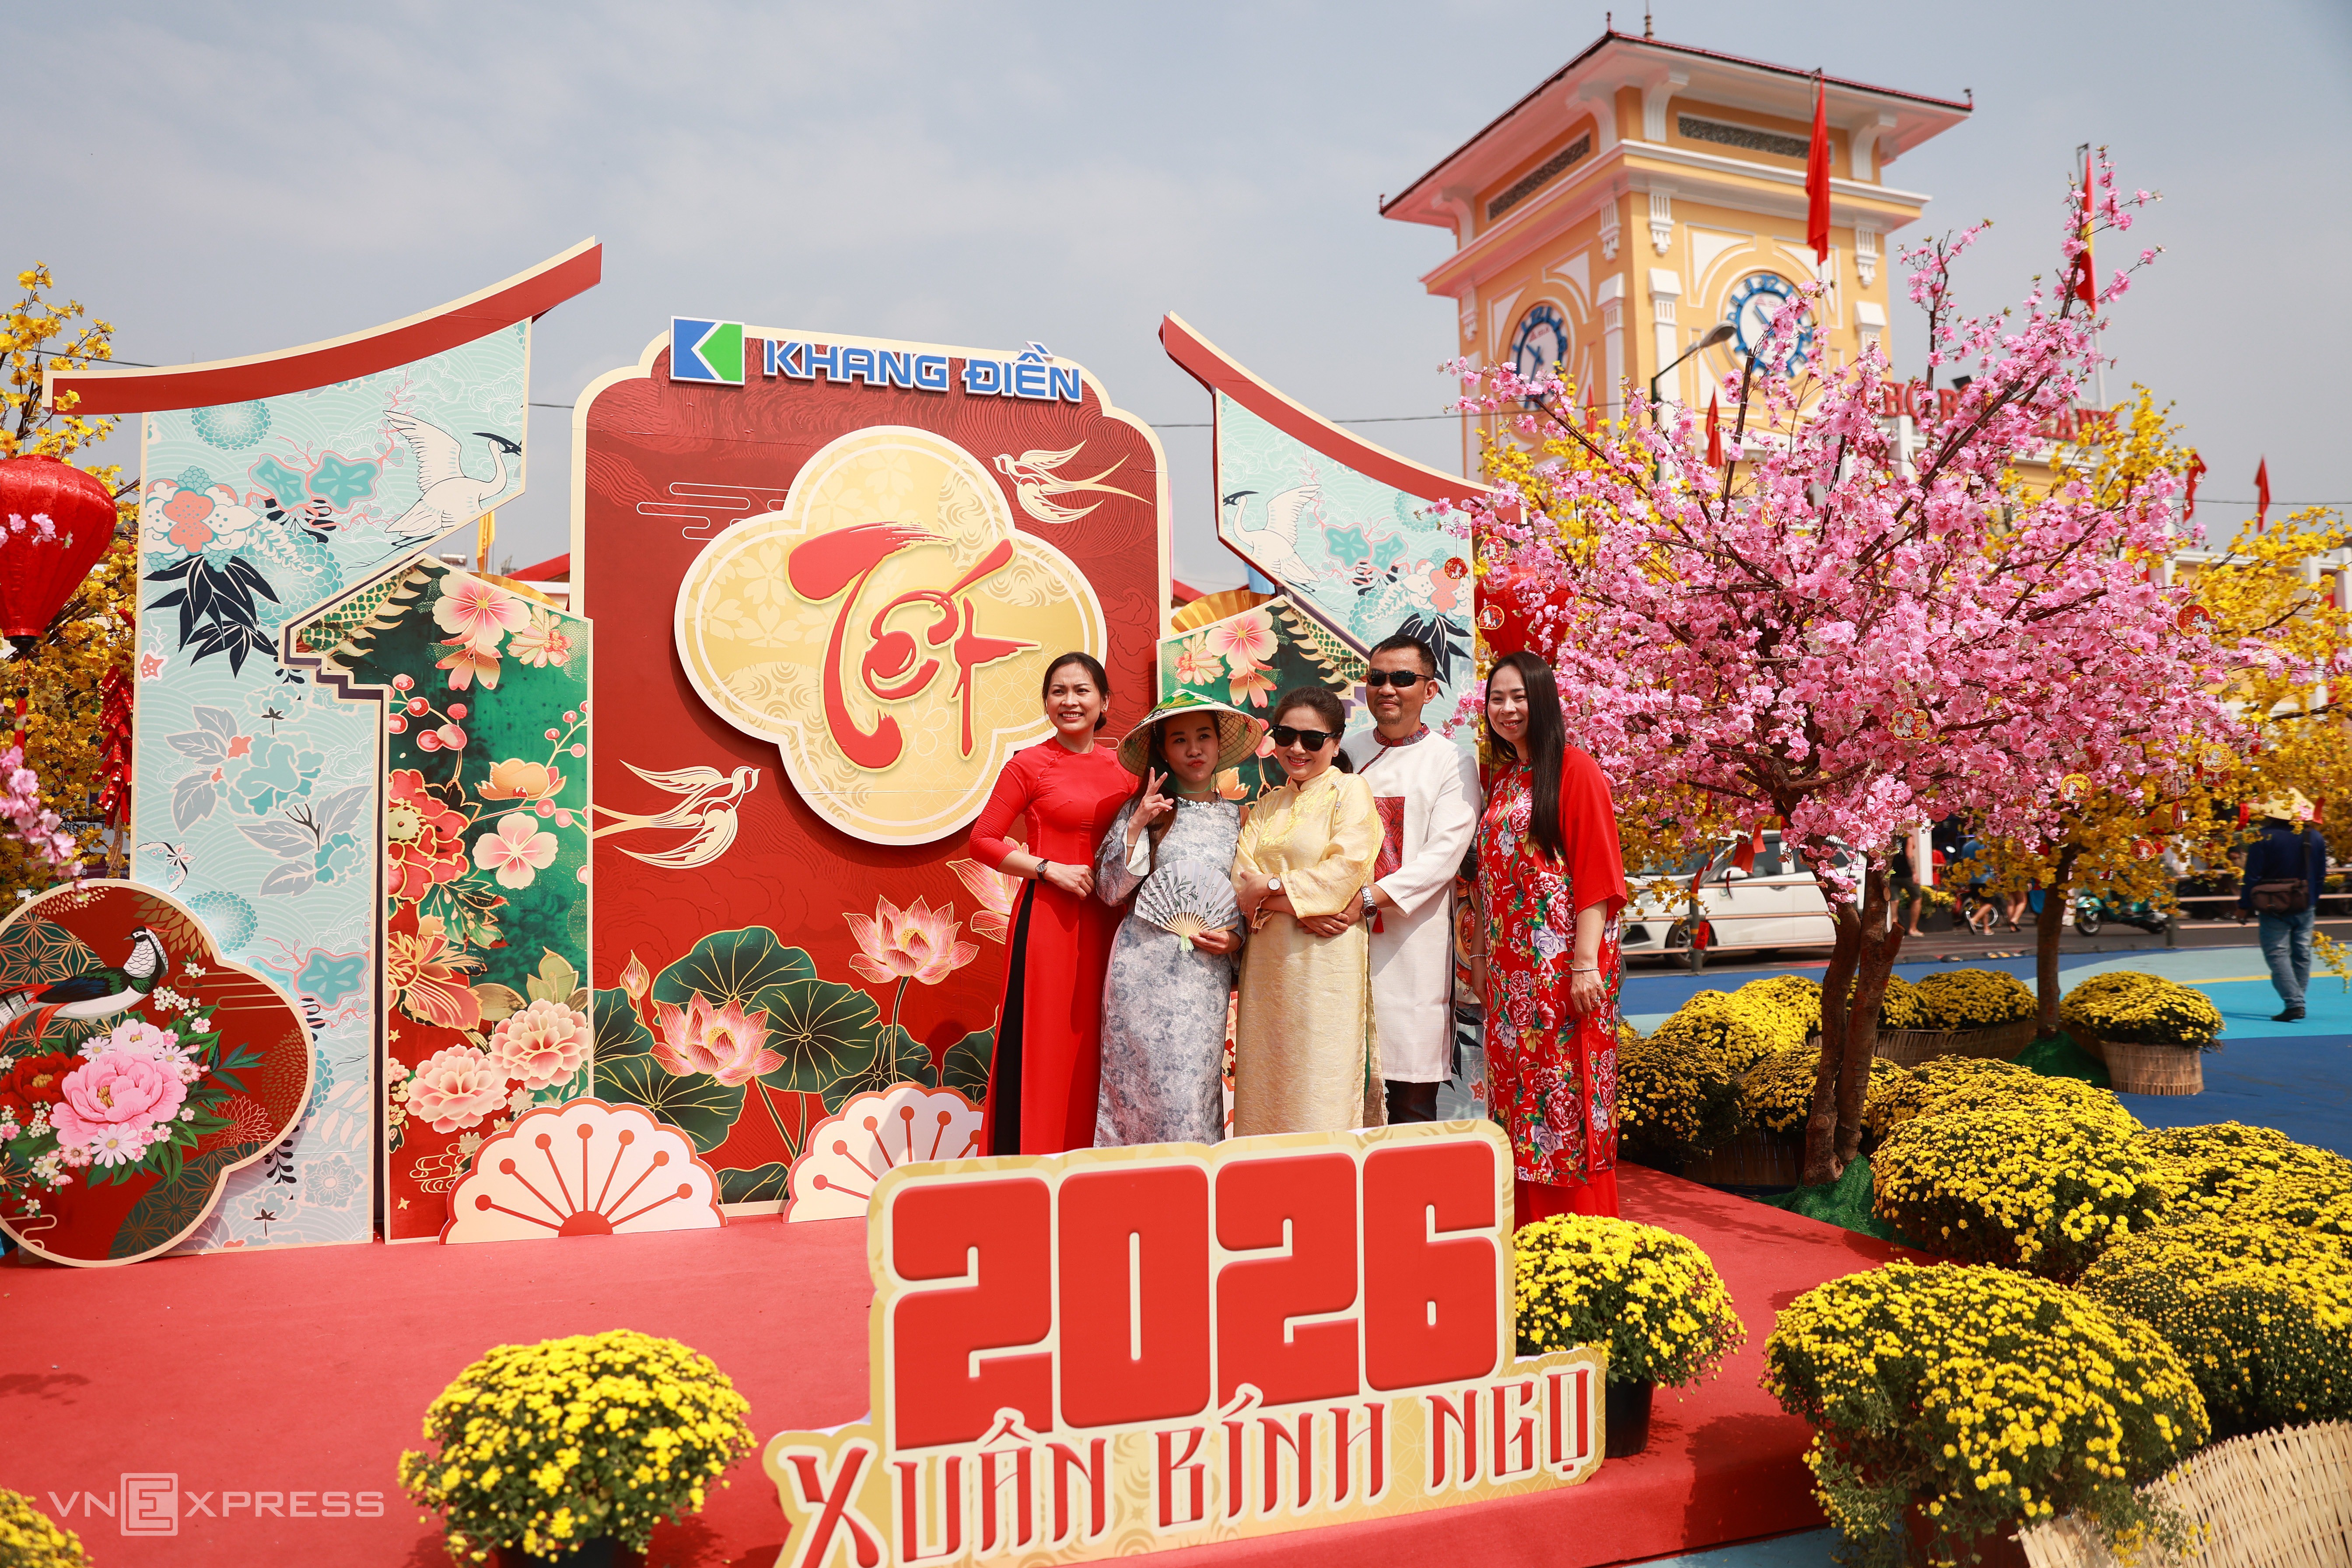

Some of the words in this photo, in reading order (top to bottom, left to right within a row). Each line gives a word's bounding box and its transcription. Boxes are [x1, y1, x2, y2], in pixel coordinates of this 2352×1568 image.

[764, 337, 949, 392] KHANG
[961, 341, 1083, 403] ĐIỀN
[788, 522, 1042, 769] Tết
[892, 1140, 1497, 1451] 2026
[788, 1417, 1106, 1568] XUÂN
[1155, 1392, 1385, 1528] BÍNH
[1426, 1368, 1589, 1488] NGỌ
